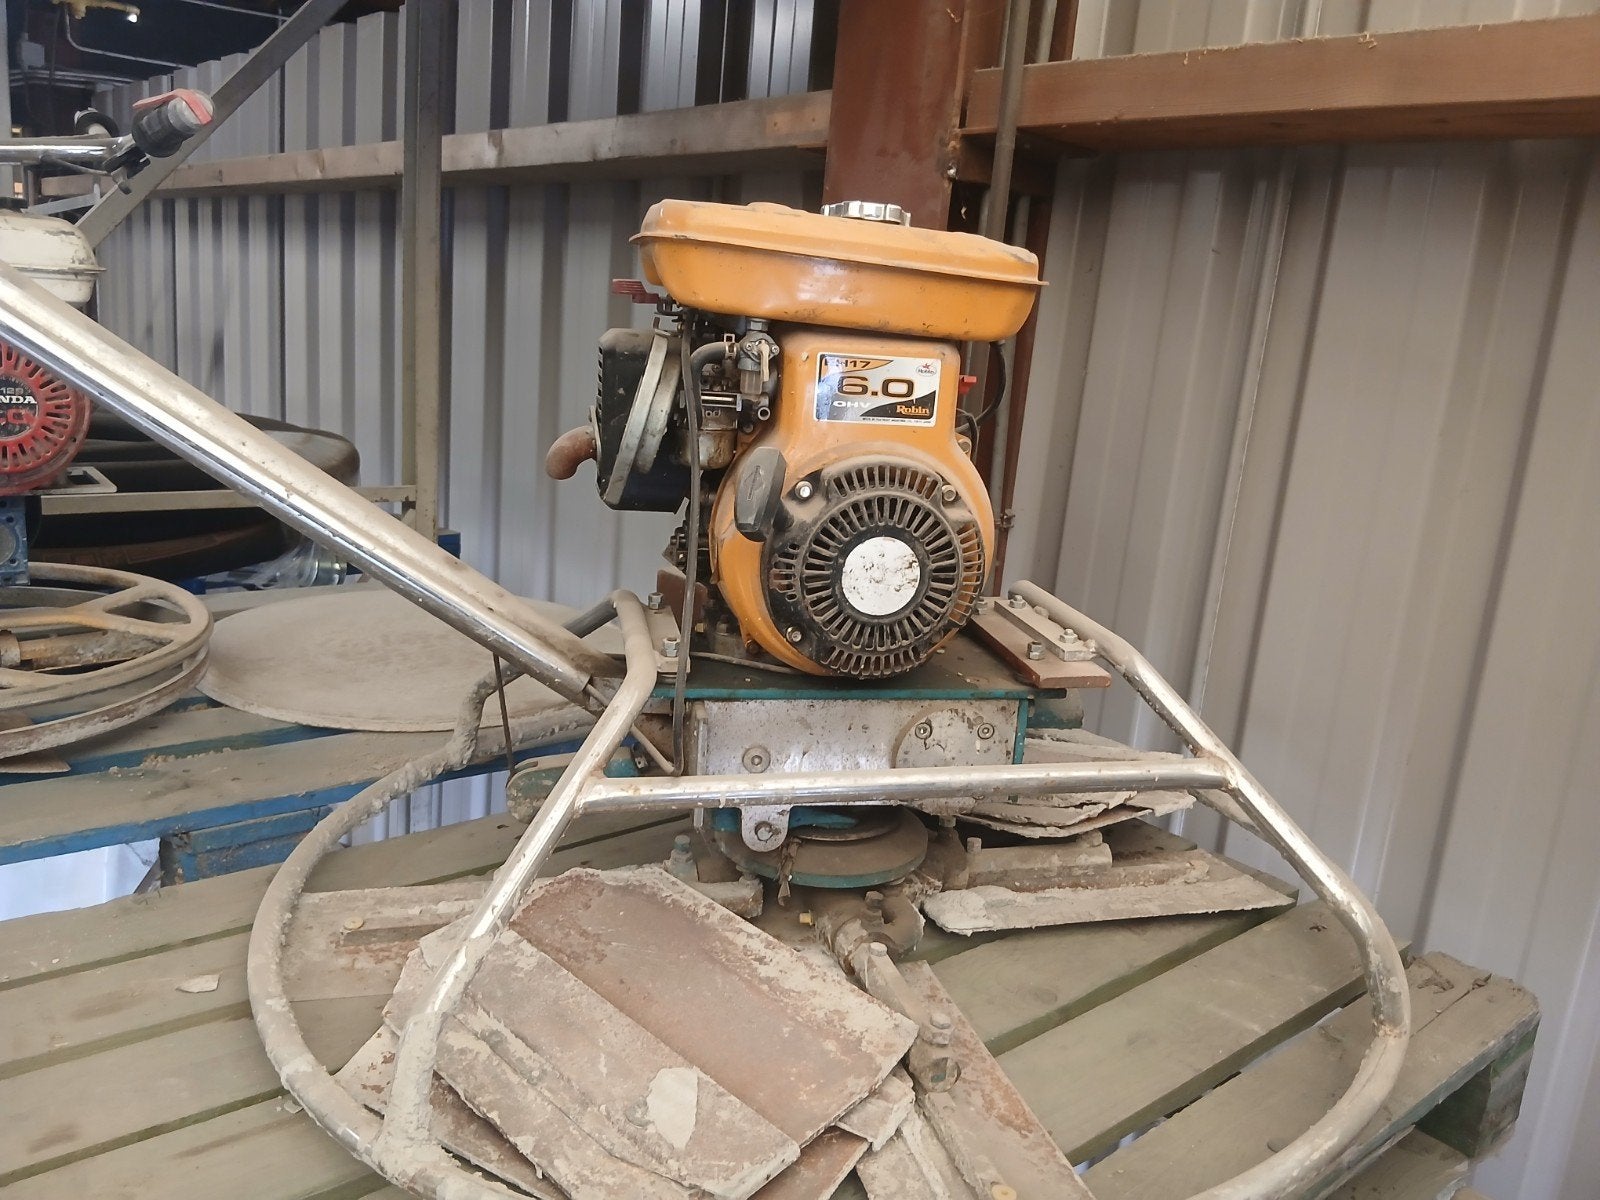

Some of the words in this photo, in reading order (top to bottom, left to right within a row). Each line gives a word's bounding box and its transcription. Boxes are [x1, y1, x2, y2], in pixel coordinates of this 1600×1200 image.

[824, 358, 872, 369] H17
[837, 375, 915, 398] 6.0
[896, 404, 930, 416] Robin
